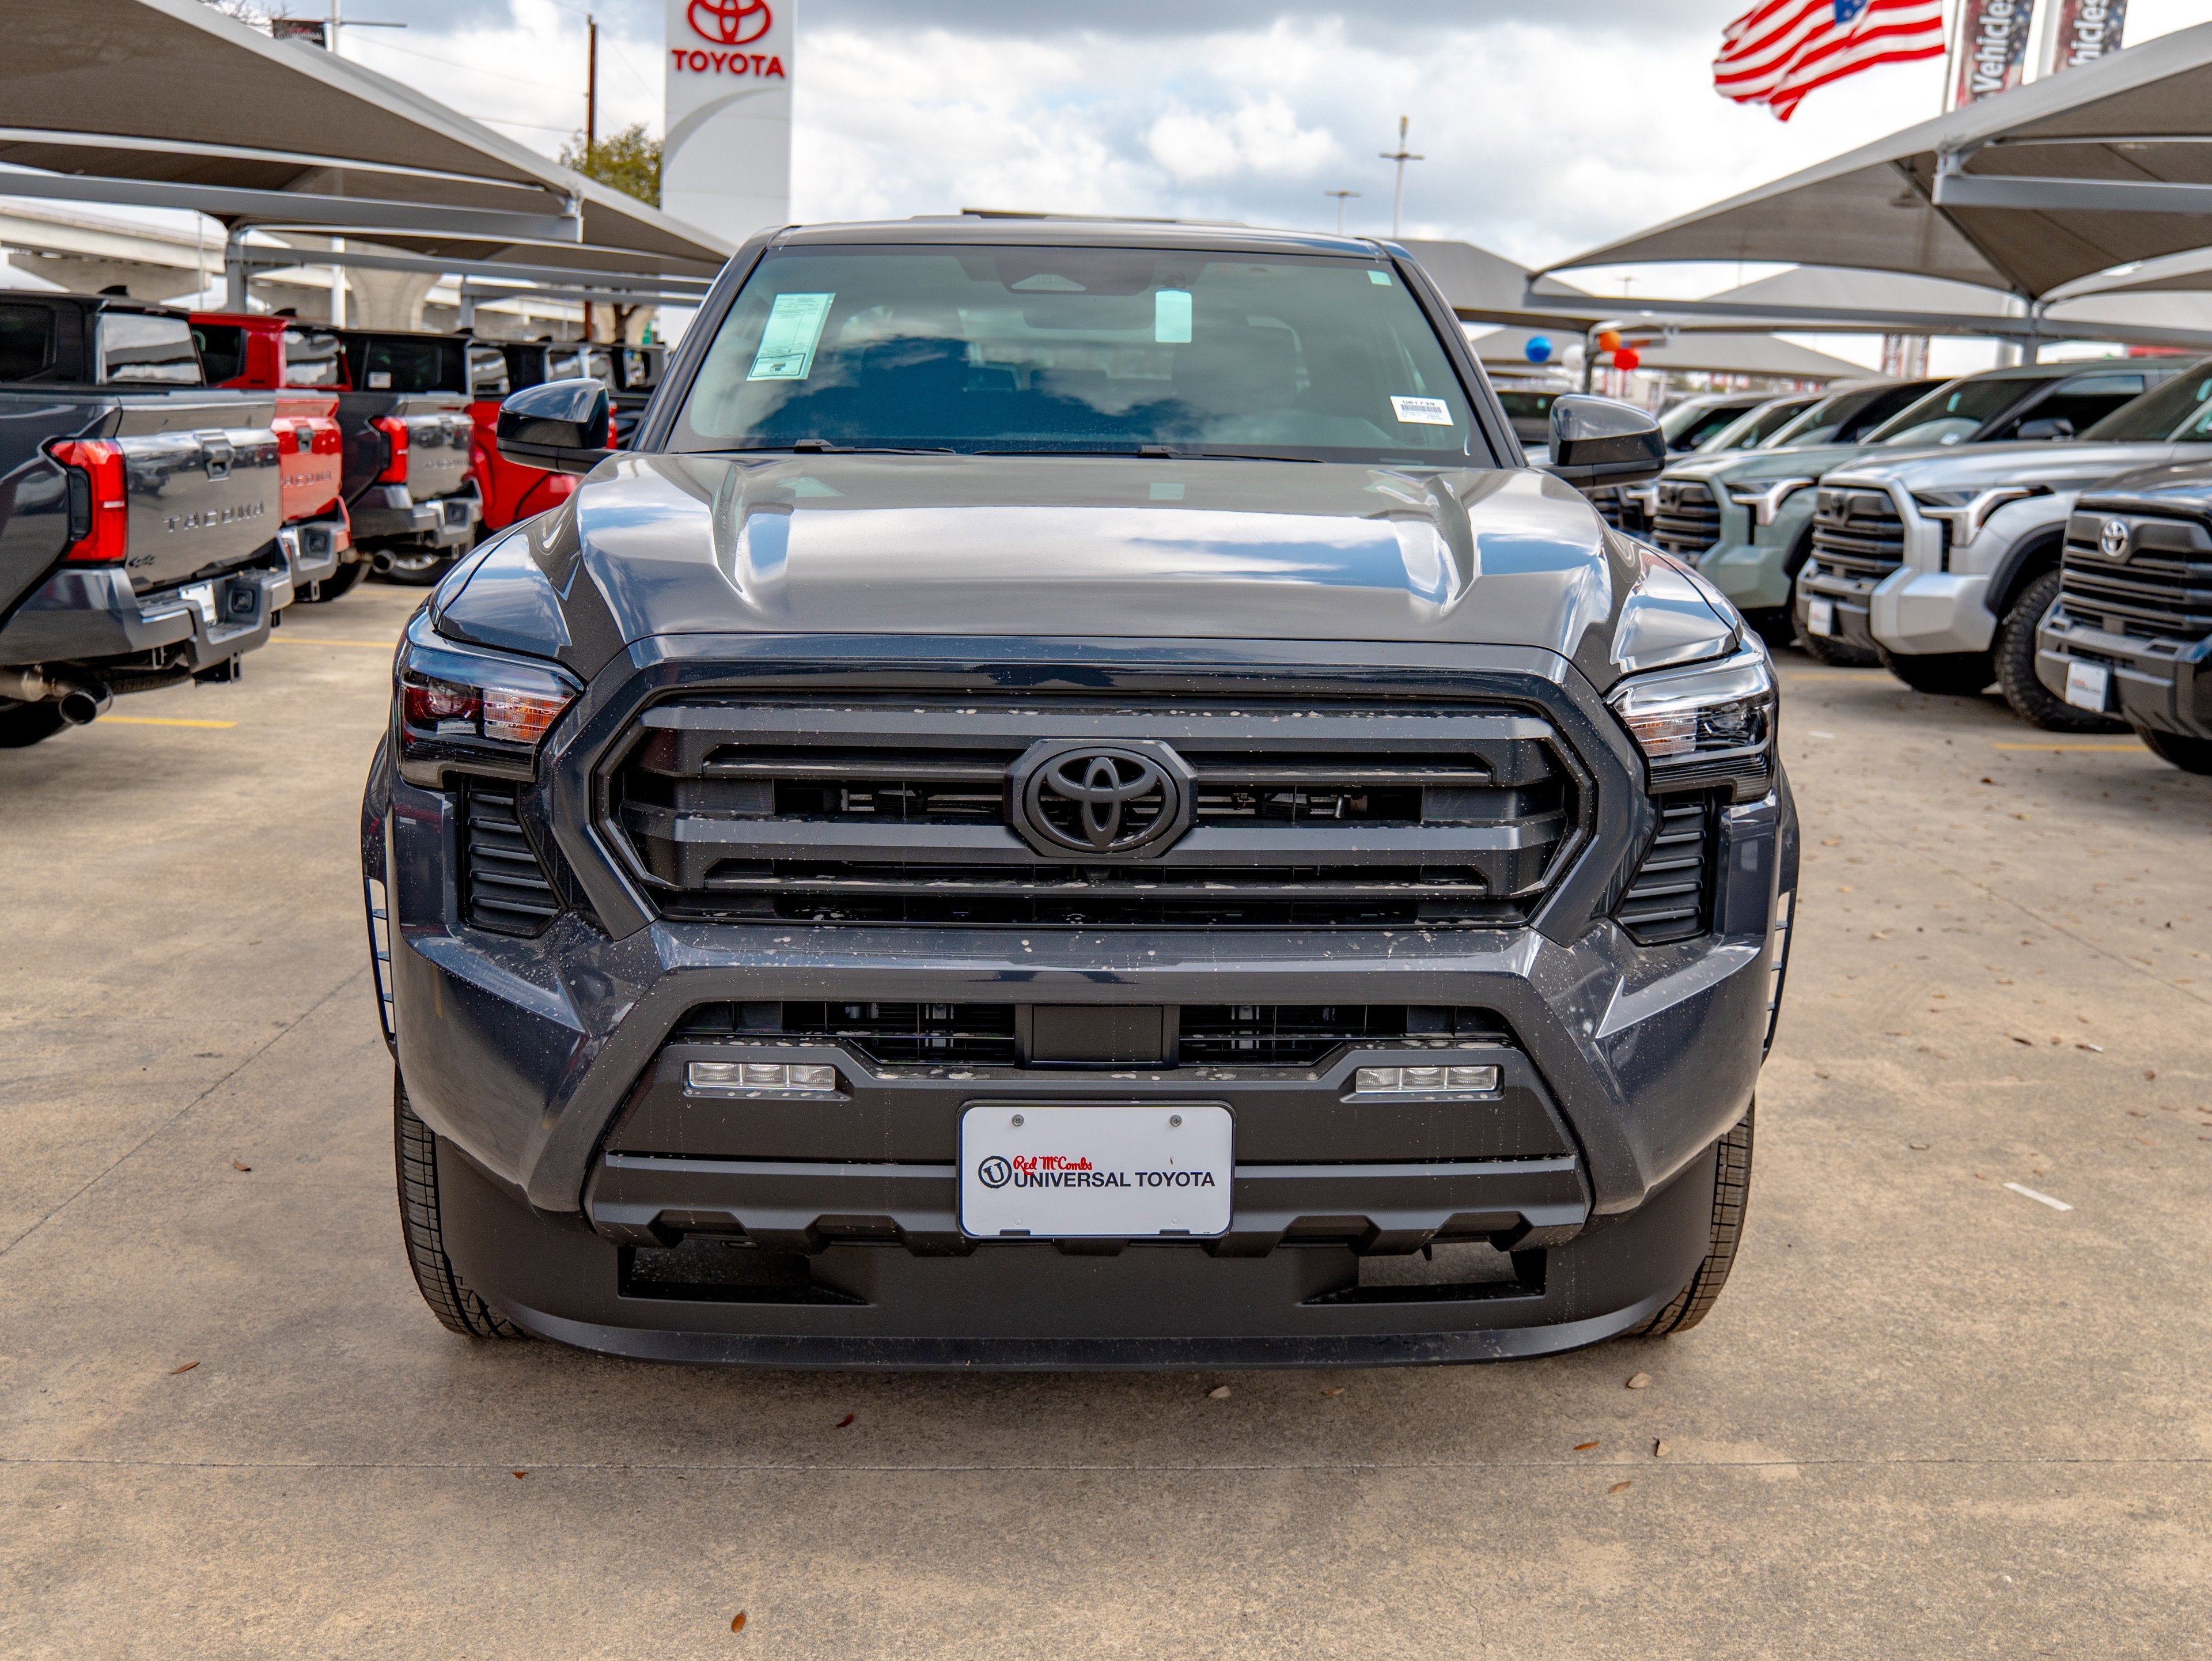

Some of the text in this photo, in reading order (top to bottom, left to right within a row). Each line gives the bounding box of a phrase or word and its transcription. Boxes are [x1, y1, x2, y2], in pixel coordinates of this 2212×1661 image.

[1971, 0, 2017, 93] Vehicle
[671, 50, 786, 78] TOYOTA
[283, 470, 332, 489] ACOMA
[162, 501, 266, 533] TACOMA
[1013, 1155, 1093, 1175] Red McCombs
[1014, 1171, 1216, 1188] UNIVERSAL TOYOTA
